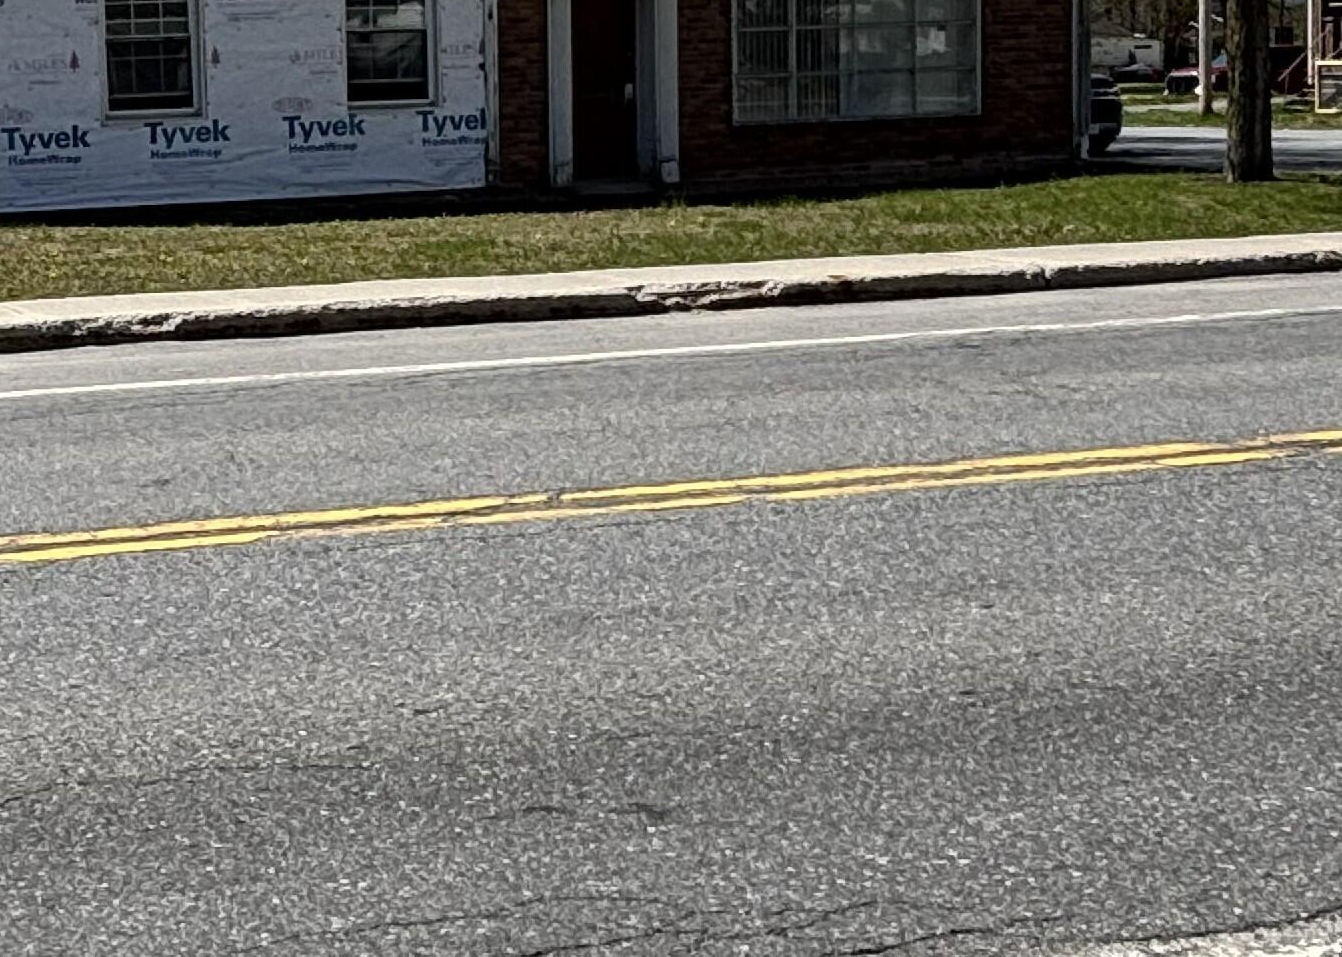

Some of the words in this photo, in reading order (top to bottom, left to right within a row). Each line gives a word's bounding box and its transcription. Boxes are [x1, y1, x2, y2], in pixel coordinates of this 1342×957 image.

[0, 125, 91, 155] Tyvek
[143, 119, 231, 149] Tyvek
[282, 113, 366, 143] Tyvek
